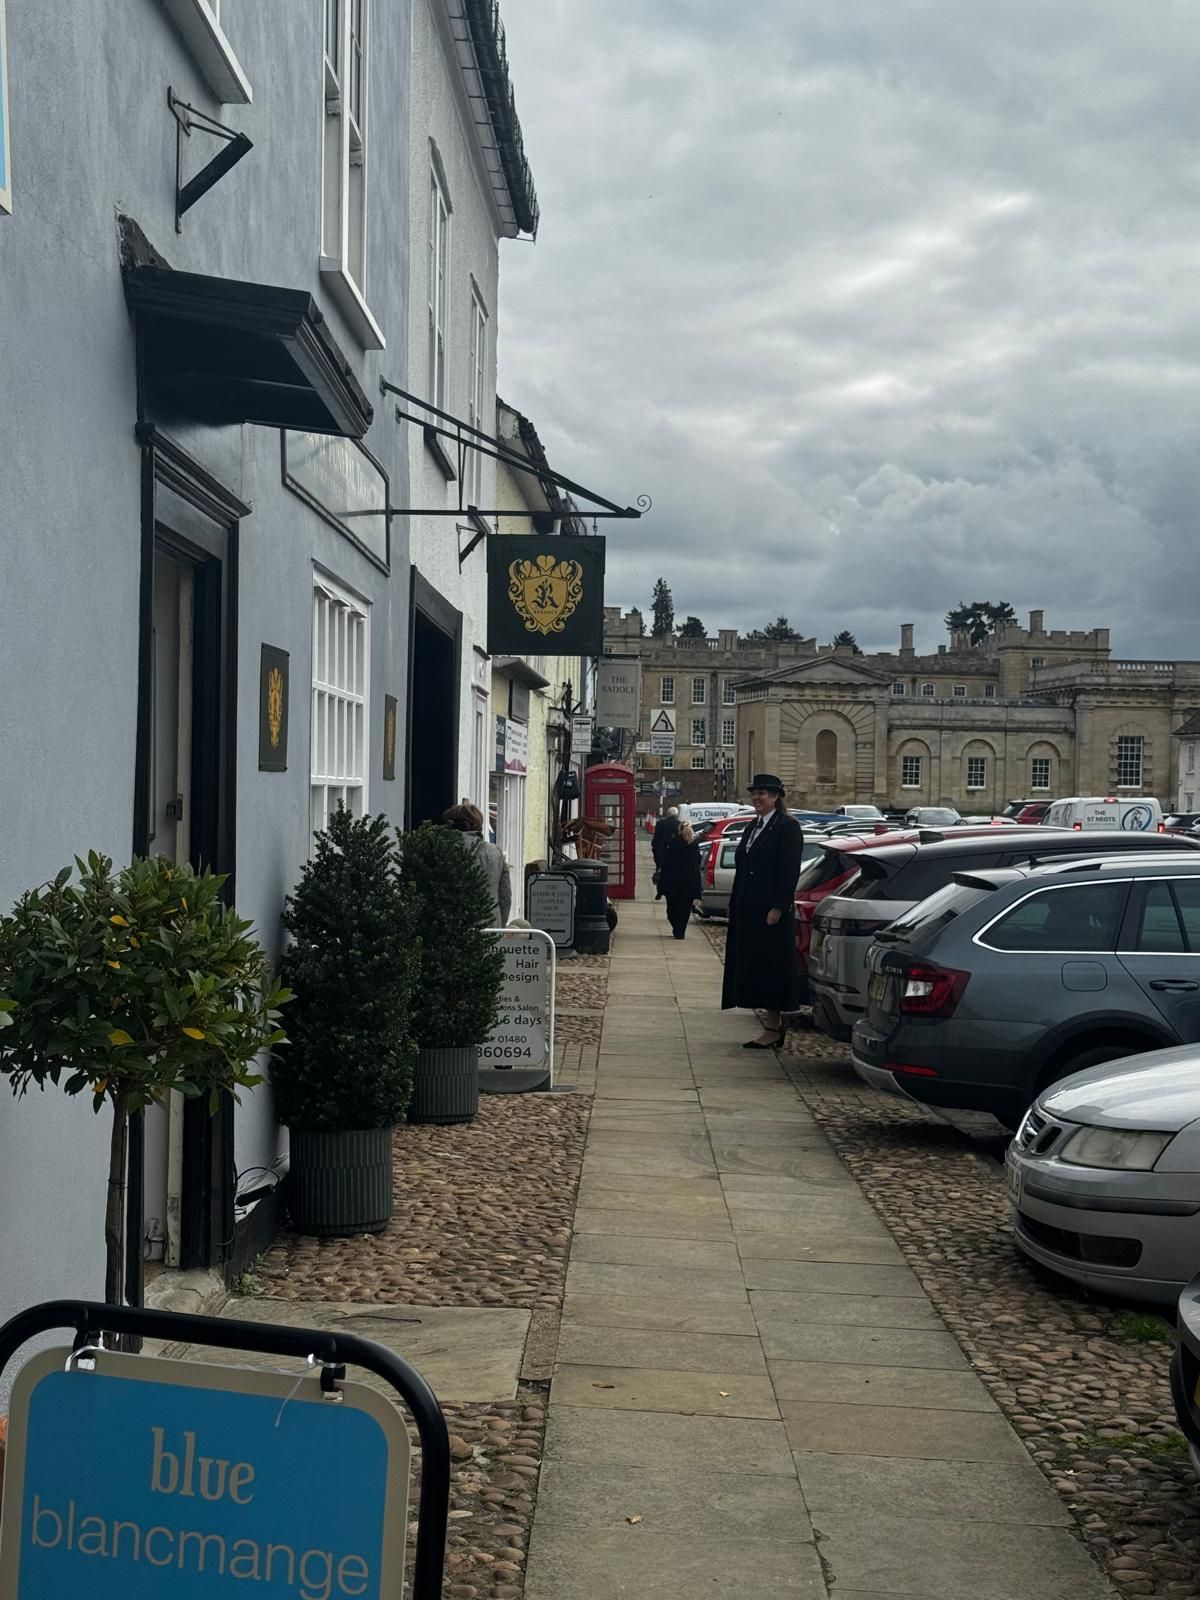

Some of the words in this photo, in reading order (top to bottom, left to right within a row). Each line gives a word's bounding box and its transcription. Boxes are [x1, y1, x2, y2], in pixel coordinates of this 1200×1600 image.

[610, 675, 628, 684] THE
[601, 685, 635, 694] SADDLE
[704, 810, 729, 818] Cleaning
[490, 944, 540, 955] houette
[515, 959, 540, 969] Hair
[496, 995, 512, 1003] dies
[514, 995, 521, 1003] &
[517, 1004, 539, 1012] Salon
[502, 1015, 511, 1025] 6
[514, 1015, 542, 1027] days
[497, 1035, 527, 1044] 01480
[150, 1426, 256, 1504] blue
[31, 1494, 369, 1600] blancmange
